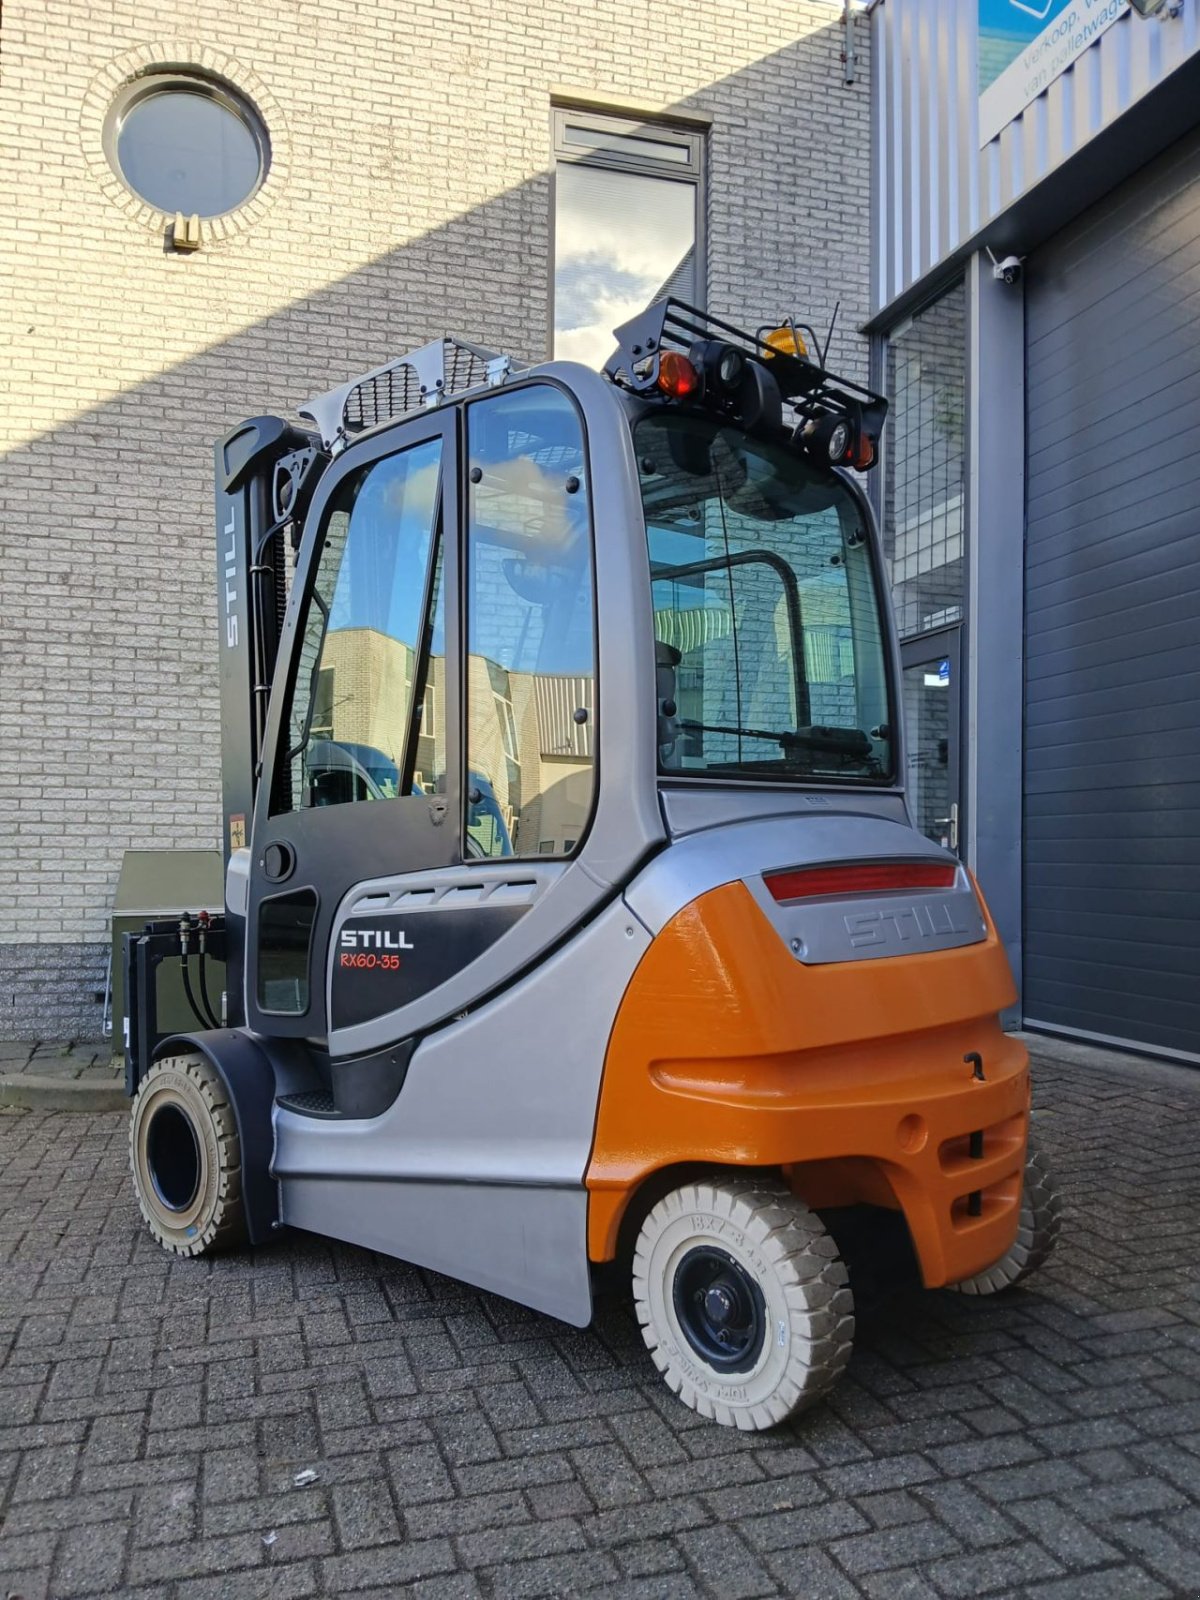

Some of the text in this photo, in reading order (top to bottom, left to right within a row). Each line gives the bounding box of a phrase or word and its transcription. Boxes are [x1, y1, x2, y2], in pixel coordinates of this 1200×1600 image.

[1023, 68, 1047, 97] van
[224, 506, 238, 648] STILL
[341, 930, 414, 949] STILL
[844, 904, 968, 948] STILL
[340, 953, 400, 969] RX60-35
